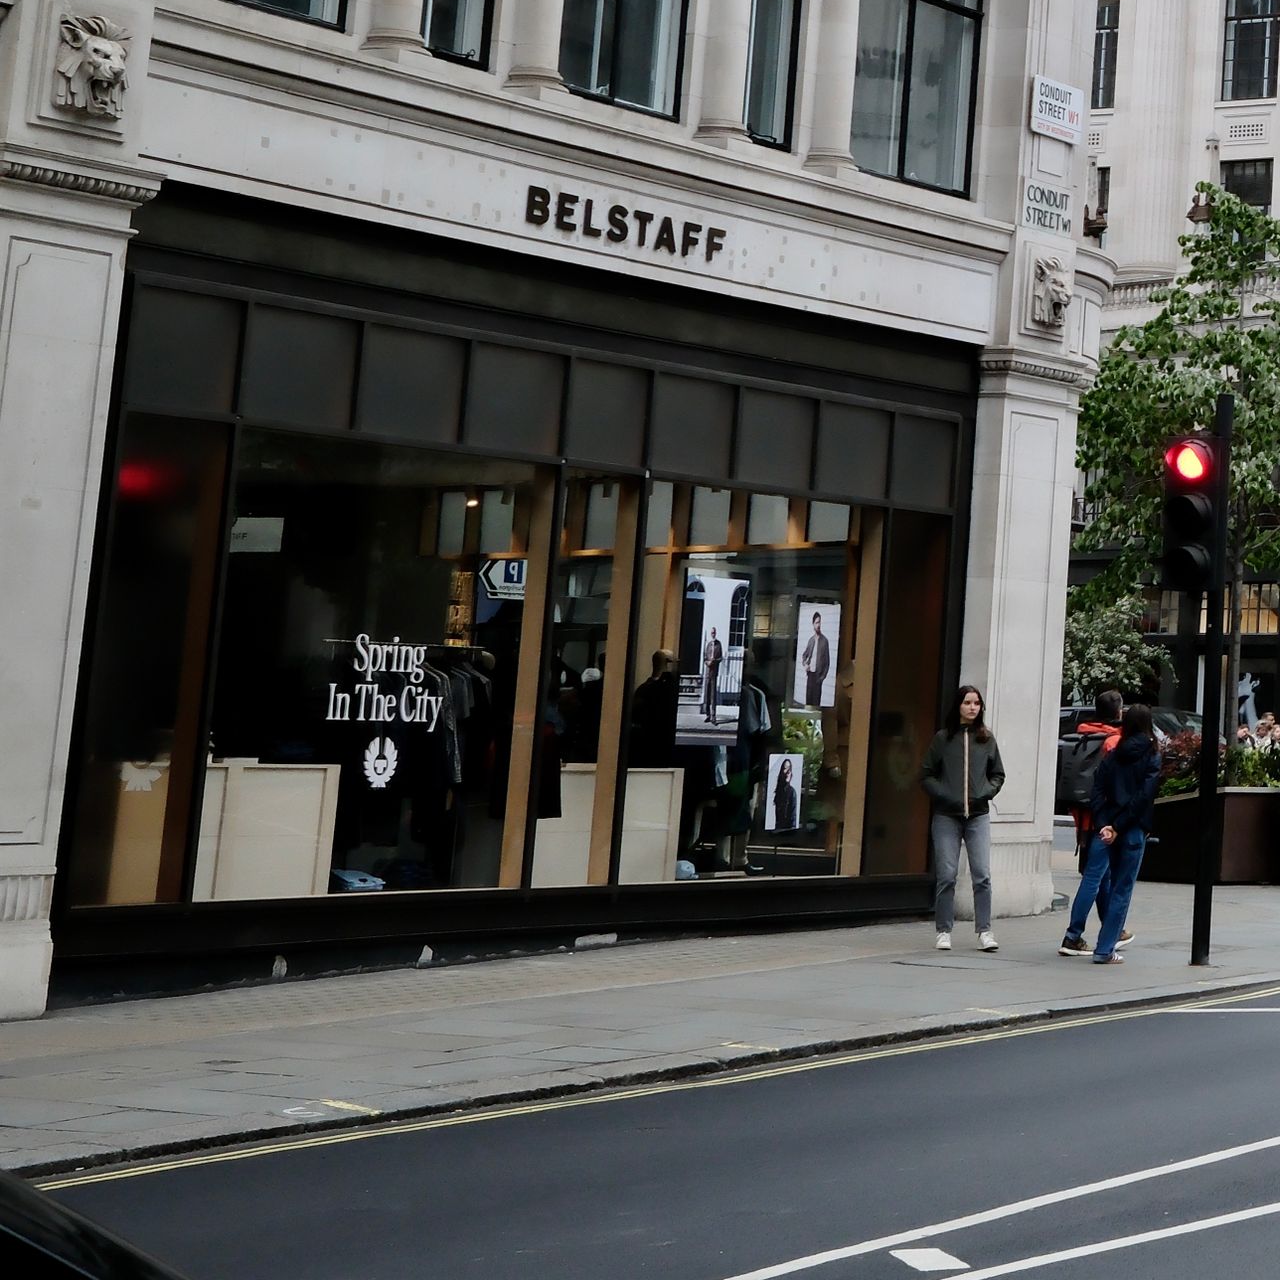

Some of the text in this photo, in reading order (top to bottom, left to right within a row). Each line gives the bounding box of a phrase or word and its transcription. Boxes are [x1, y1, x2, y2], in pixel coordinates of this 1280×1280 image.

[1040, 82, 1072, 105] CONDUIT
[1039, 99, 1080, 126] STREET W1
[1027, 184, 1070, 211] CONDUIT
[525, 185, 727, 262] BELSTAFF
[1026, 205, 1071, 233] STREET W1
[353, 633, 428, 684] Spring
[325, 683, 444, 733] In The City
